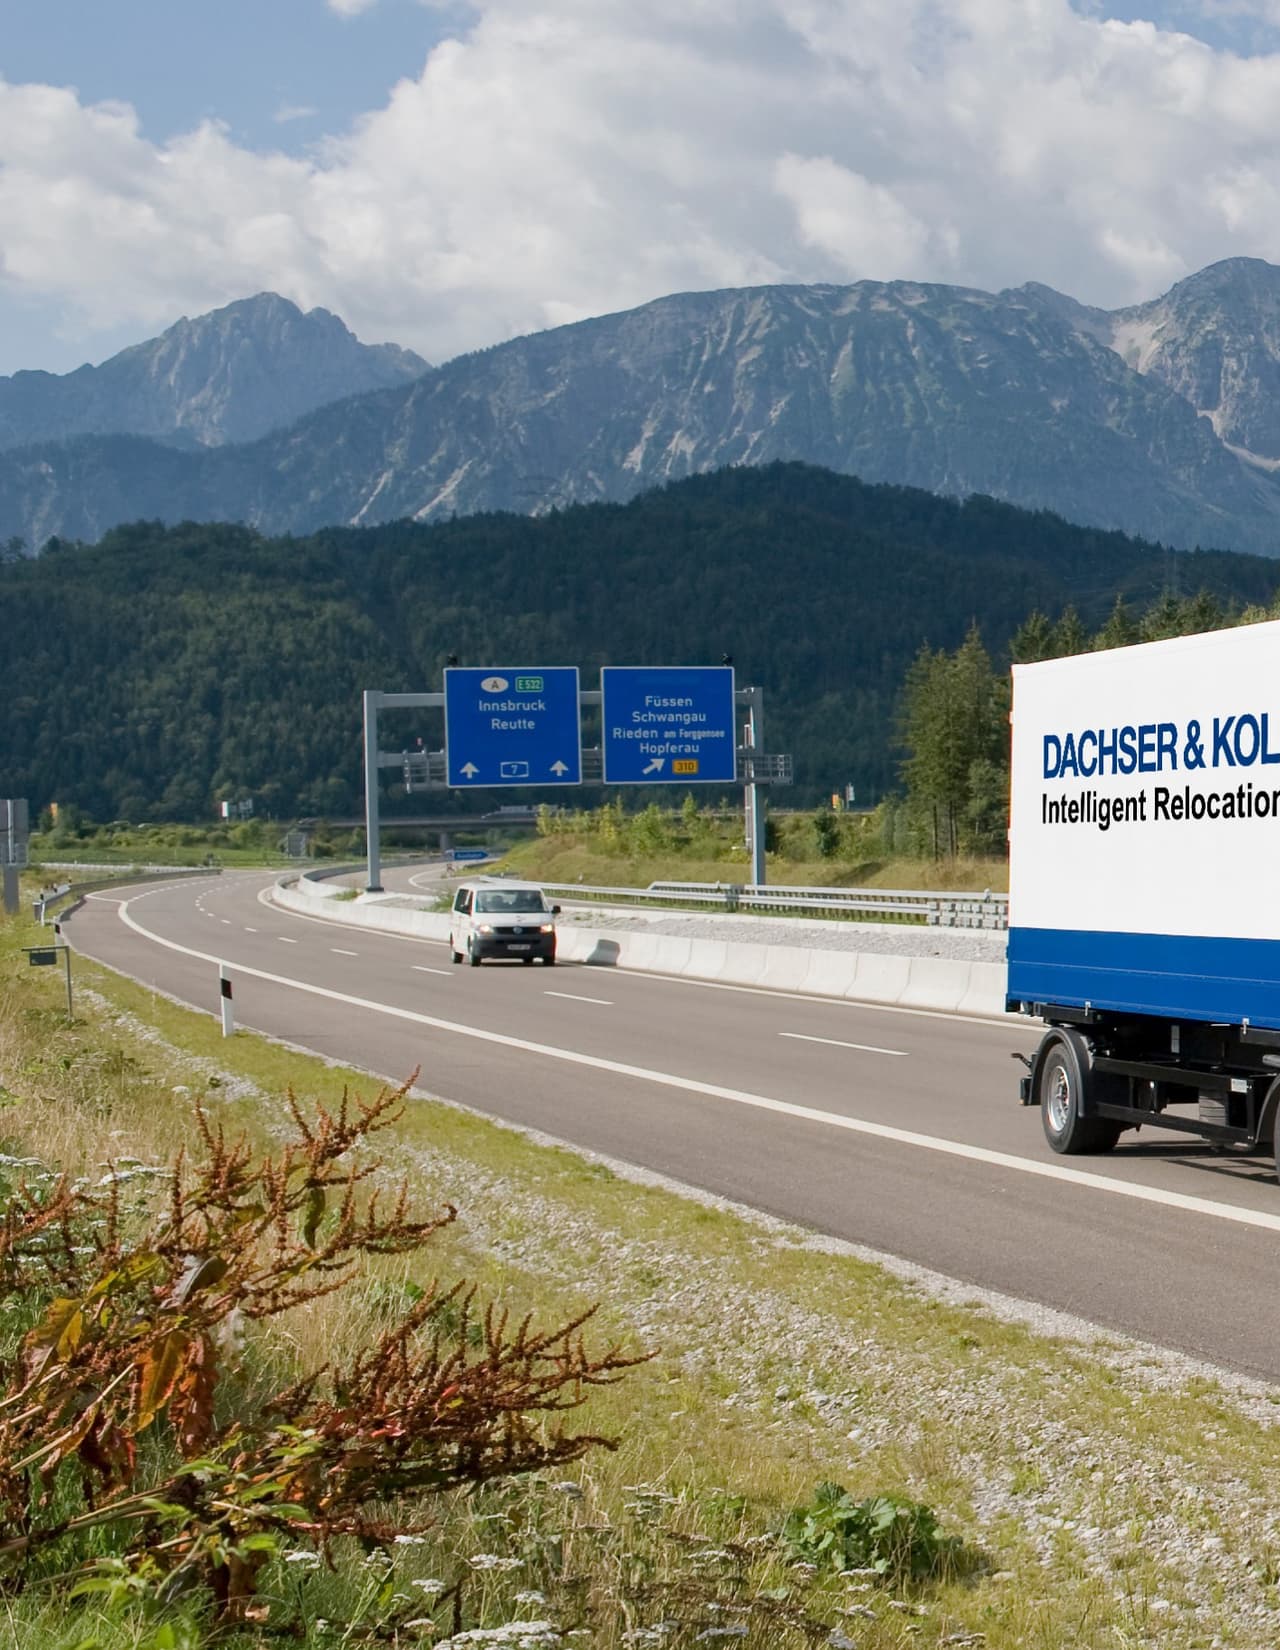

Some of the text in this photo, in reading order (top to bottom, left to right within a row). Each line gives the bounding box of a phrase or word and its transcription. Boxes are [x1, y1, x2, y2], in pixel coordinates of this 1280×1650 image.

[479, 700, 546, 711] Innsbruck
[645, 695, 693, 707] Füssen
[491, 718, 535, 730] Reutte
[632, 711, 707, 725] Schwangau
[613, 728, 658, 739] Rieden
[640, 742, 700, 756] Hopferau
[1044, 723, 1179, 779] DACHSER
[1184, 720, 1206, 770] &
[1043, 789, 1147, 831] Intelligent
